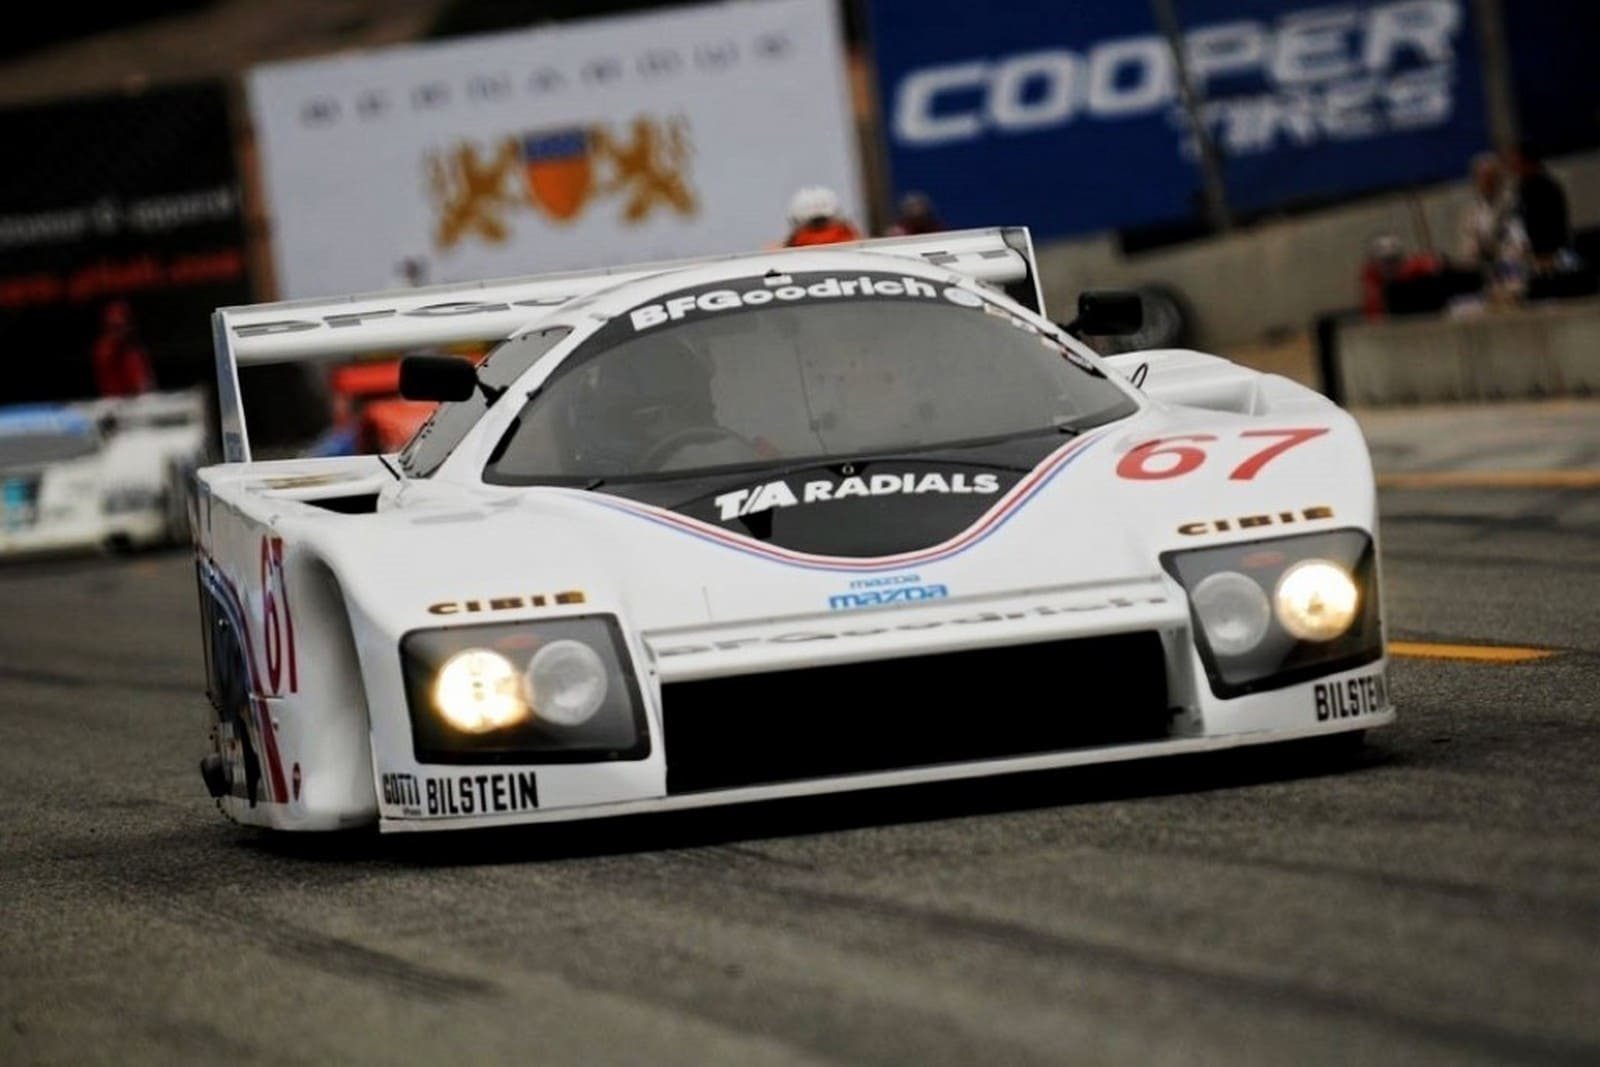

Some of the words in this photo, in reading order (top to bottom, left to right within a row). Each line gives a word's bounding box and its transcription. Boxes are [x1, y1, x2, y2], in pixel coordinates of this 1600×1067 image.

[894, 0, 1462, 146] COOPER
[1170, 64, 1452, 160] TIRES
[629, 275, 937, 332] BFGoodrich
[1115, 427, 1330, 481] 67
[714, 480, 798, 521] T/A
[803, 473, 1000, 503] RADIALS
[829, 583, 948, 610] mazda
[850, 573, 921, 589] mazda
[261, 536, 298, 695] 67
[426, 771, 540, 815] BILSTEIN
